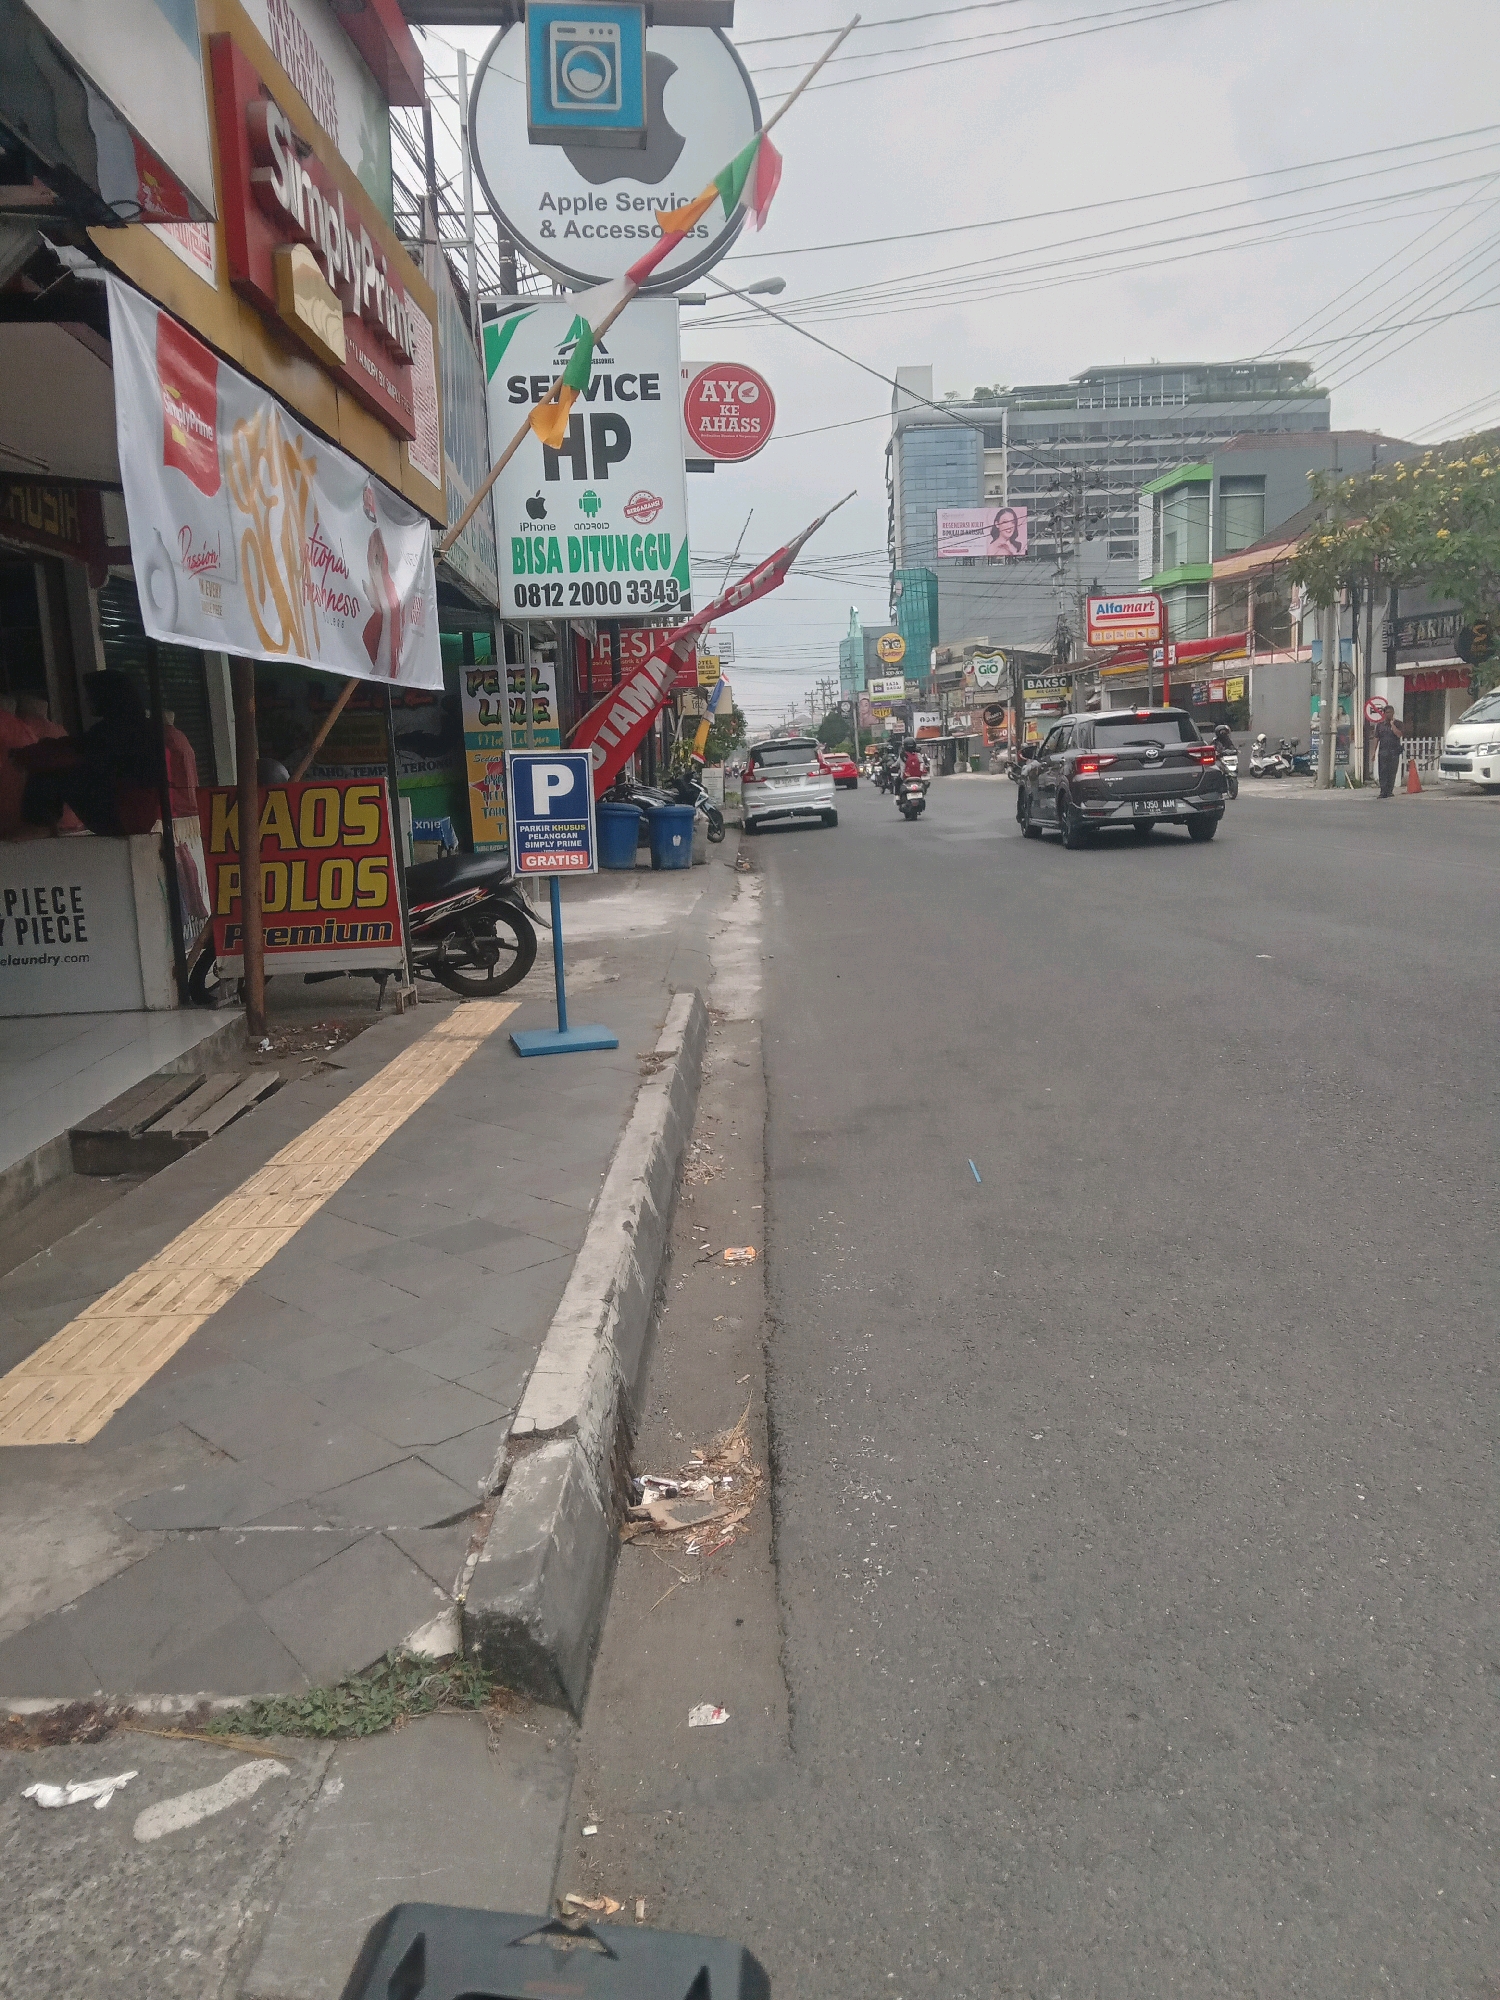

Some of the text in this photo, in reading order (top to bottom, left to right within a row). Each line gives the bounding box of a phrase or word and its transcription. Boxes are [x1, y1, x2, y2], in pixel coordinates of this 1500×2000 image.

[538, 192, 699, 215] Apple Servic
[266, 100, 417, 362] SimplyPrime
[539, 219, 709, 239] & Accessoes
[163, 391, 214, 442] SimplyPrime
[719, 404, 740, 416] KE
[698, 416, 761, 433] AHASS
[542, 412, 632, 482] HP
[519, 522, 557, 532] iPhone
[511, 533, 672, 575] BISA DITUNGGU
[513, 578, 679, 608] 0812 2000 3343
[1096, 601, 1156, 615] Alfamart
[1027, 678, 1067, 689] BAKSO
[531, 764, 575, 816] P
[209, 784, 382, 854] KAOS
[519, 823, 586, 833] PARKIR KHUSUS
[524, 839, 583, 849] SIMPLY PRIME
[528, 832, 578, 840] PELANGGAN
[525, 854, 584, 867] GRATIS!
[217, 855, 389, 916] POLOS
[3, 886, 84, 917] PIECE
[14, 914, 89, 946] PIECE
[223, 917, 394, 951] Pemium
